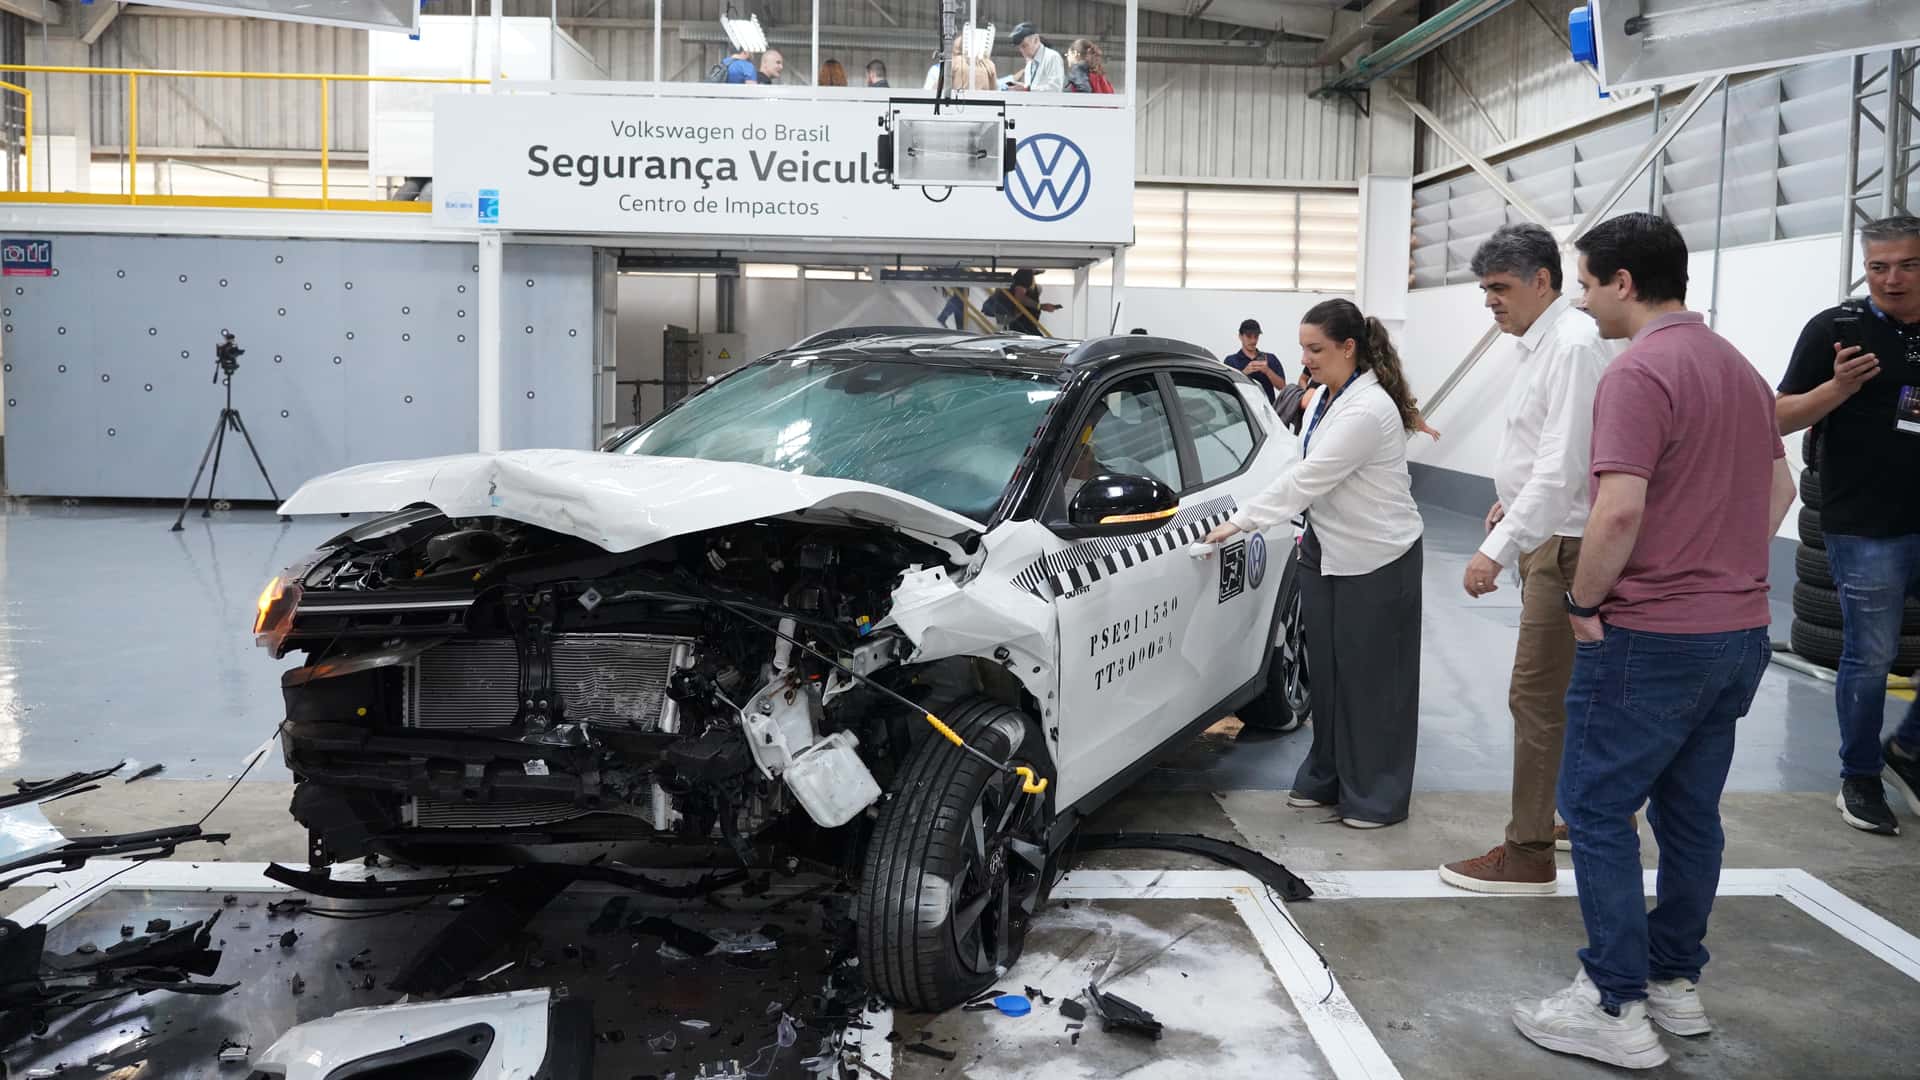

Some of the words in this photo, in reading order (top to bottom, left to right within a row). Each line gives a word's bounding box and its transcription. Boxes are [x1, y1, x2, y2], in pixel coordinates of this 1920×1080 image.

[610, 119, 735, 145] Volkswagen
[741, 123, 768, 142] do
[775, 123, 831, 143] Brasil
[527, 144, 739, 189] Segurança
[749, 149, 893, 185] Veicula
[1004, 133, 1091, 222] VW
[618, 193, 687, 214] Centro
[692, 196, 719, 214] de
[725, 196, 820, 219] Impactos
[1064, 584, 1091, 600] OUTFIT
[1090, 595, 1179, 657] PSE211530
